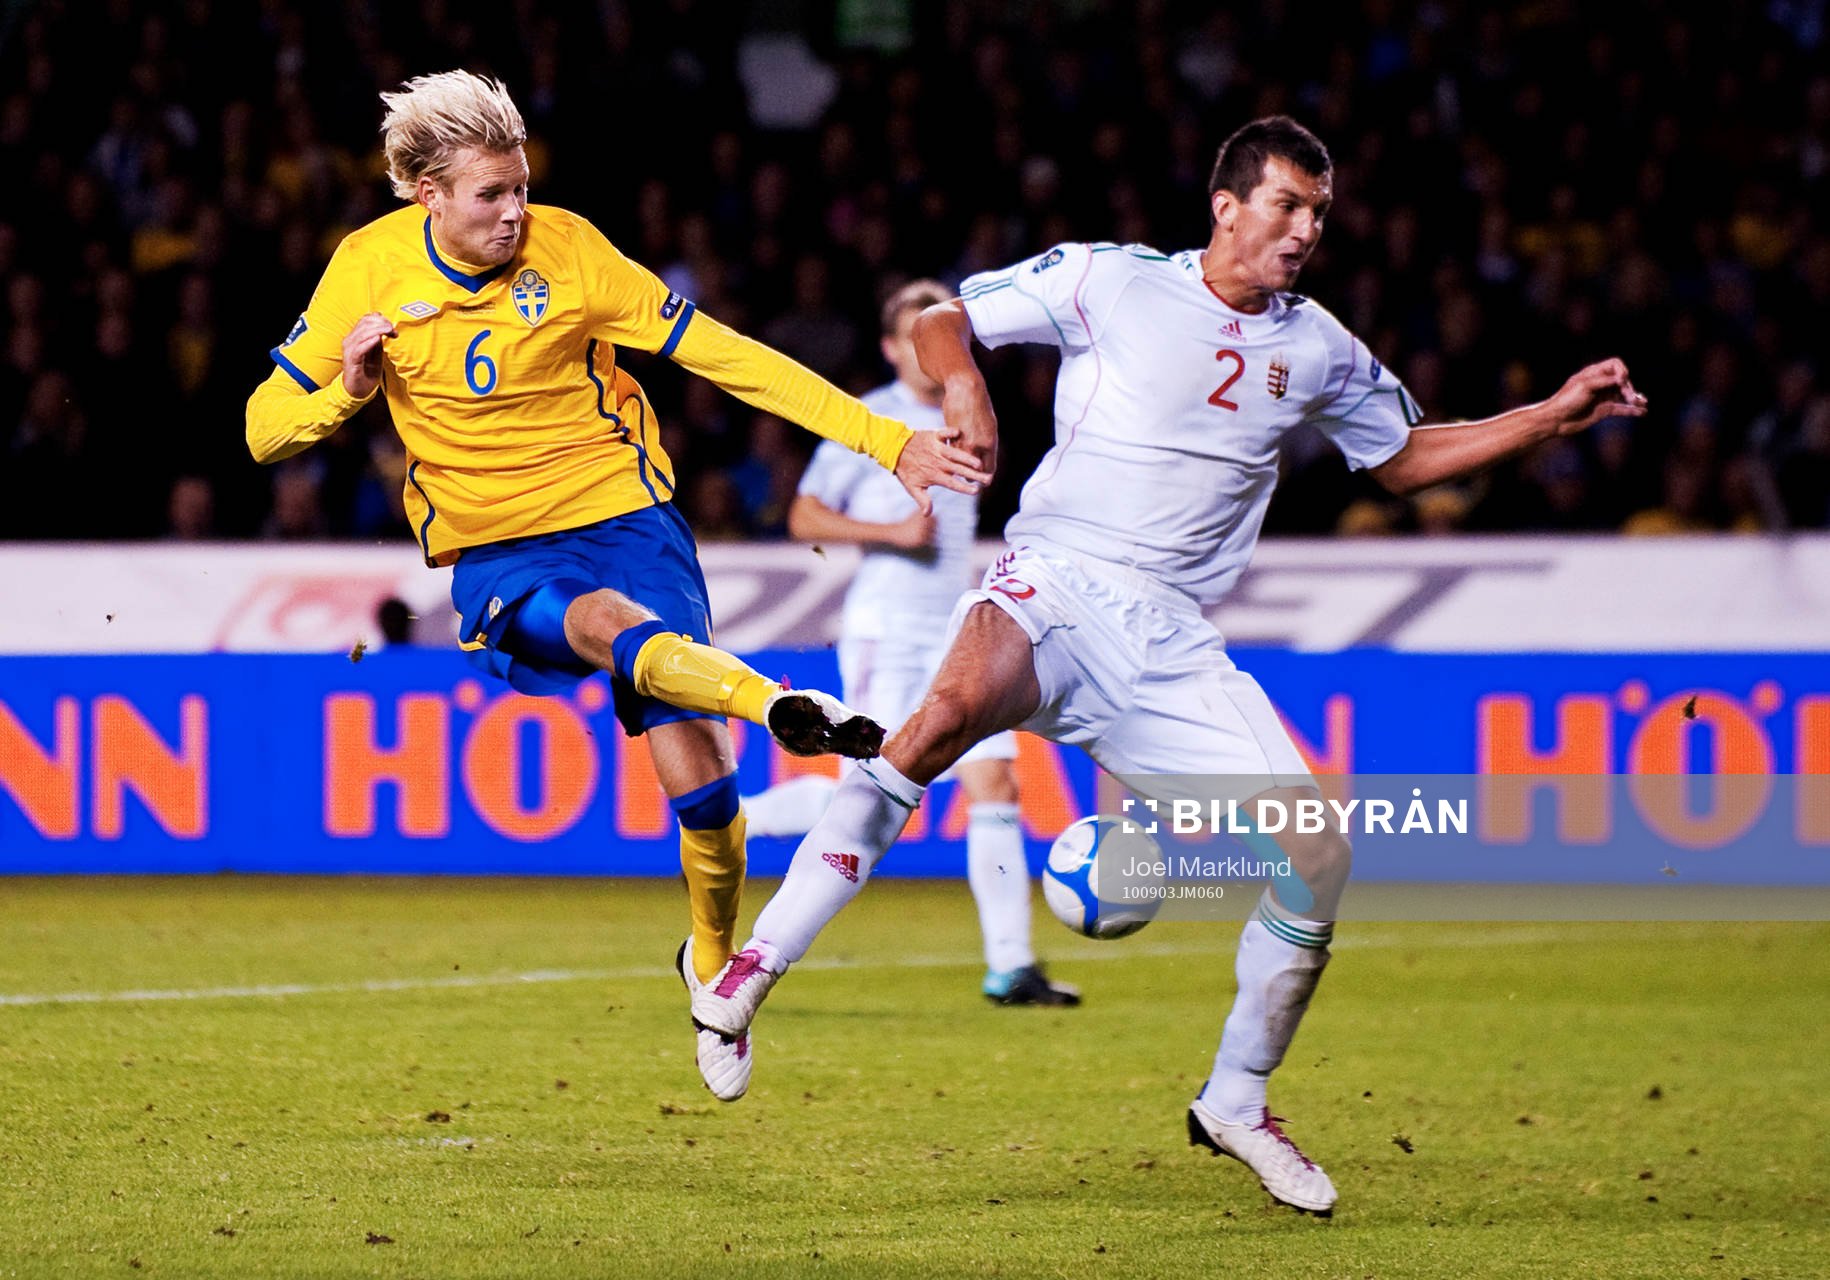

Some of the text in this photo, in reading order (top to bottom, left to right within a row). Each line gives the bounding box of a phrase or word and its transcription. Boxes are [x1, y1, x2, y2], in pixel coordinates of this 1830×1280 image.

[465, 329, 497, 396] 6
[1207, 348, 1245, 411] 2
[822, 852, 859, 883] adidas
